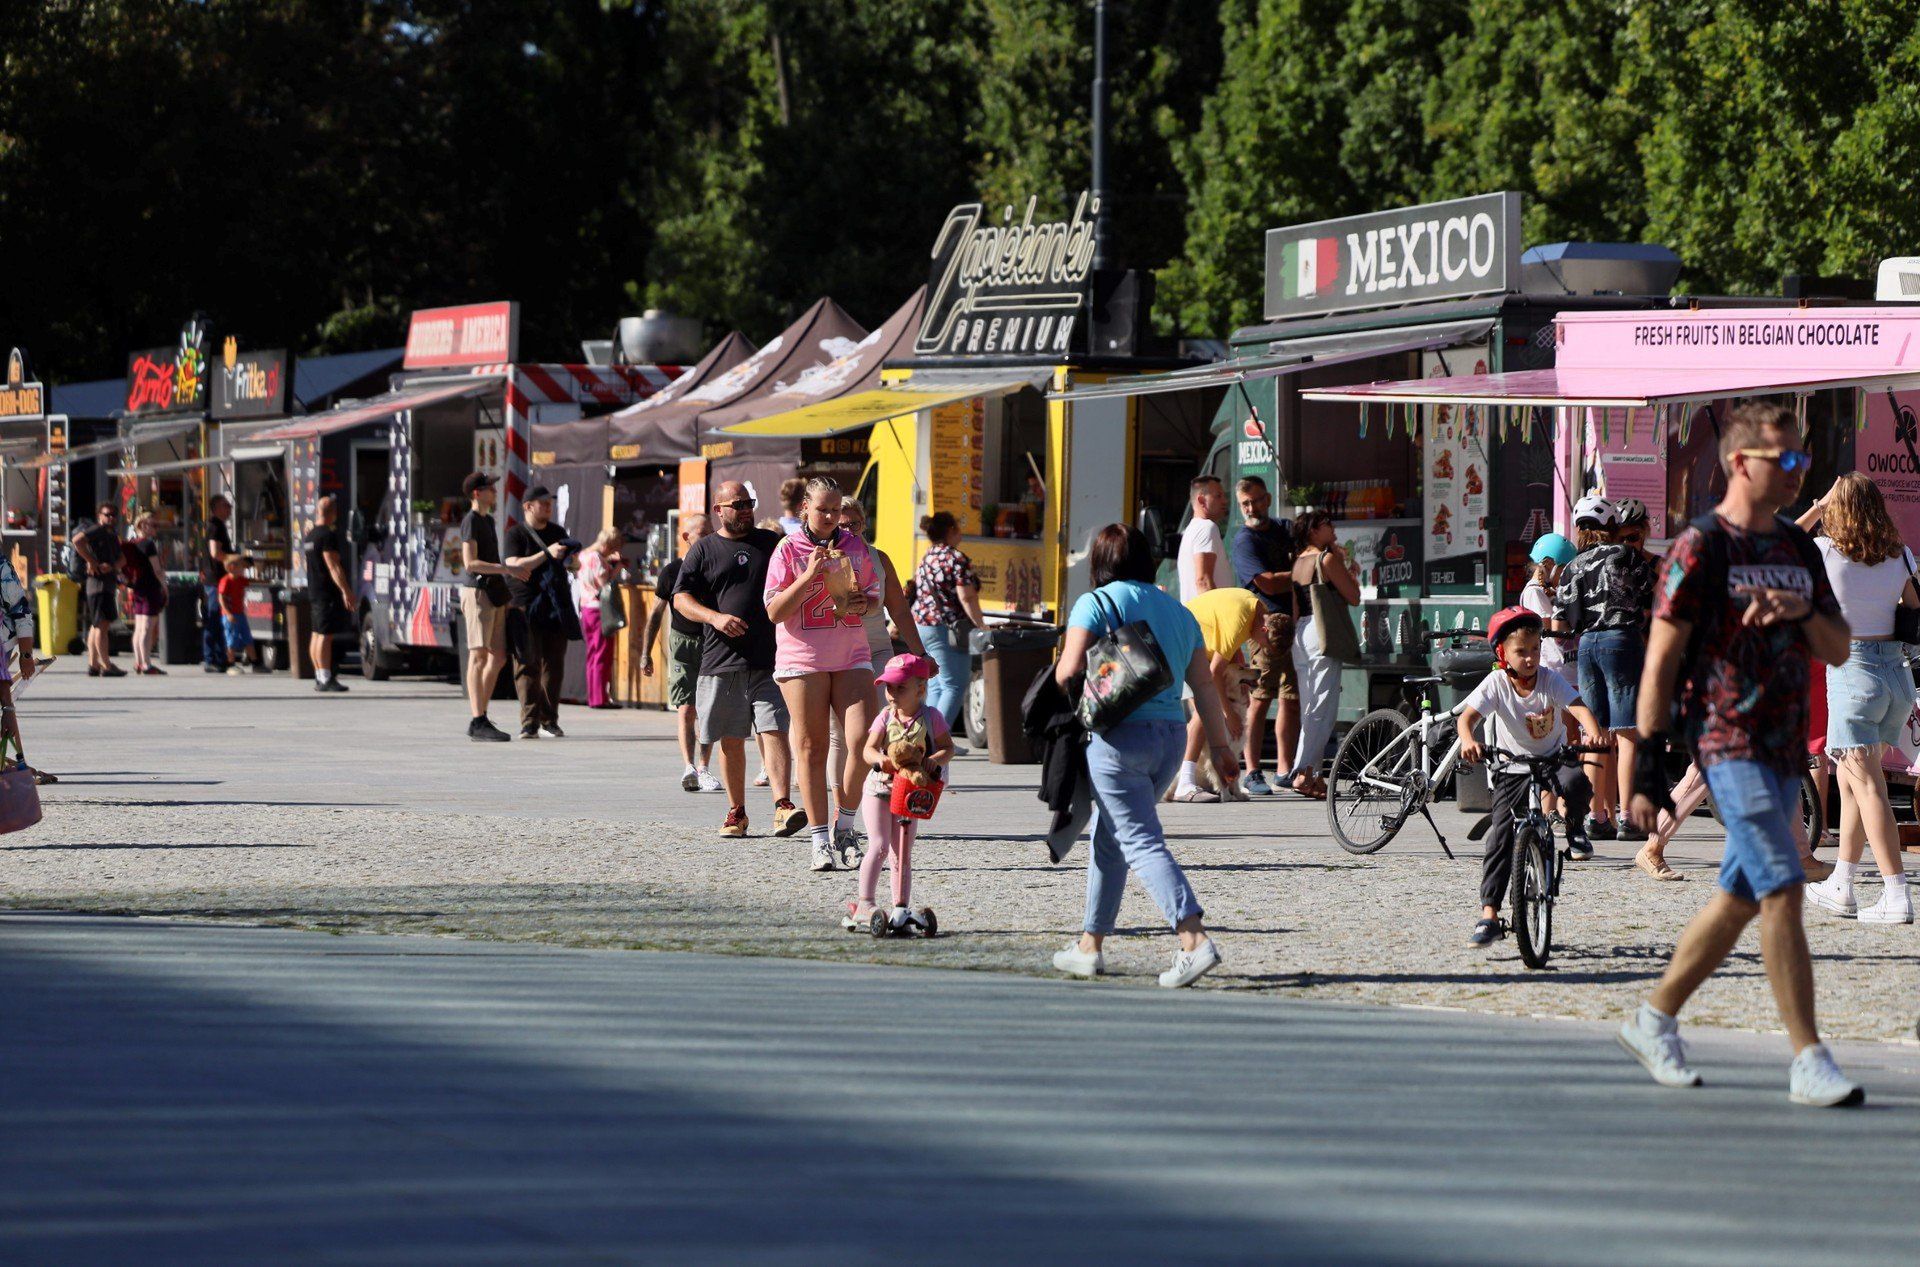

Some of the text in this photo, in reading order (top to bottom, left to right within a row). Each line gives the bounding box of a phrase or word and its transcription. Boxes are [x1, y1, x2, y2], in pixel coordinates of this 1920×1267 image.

[1345, 212, 1495, 296] MEXICO
[951, 315, 1075, 352] PREMIUM
[1635, 324, 1880, 346] FRESH FRUITS IN BELGIAN CHOCOLATE
[1379, 561, 1412, 585] MEXICO
[801, 571, 864, 632] 2
